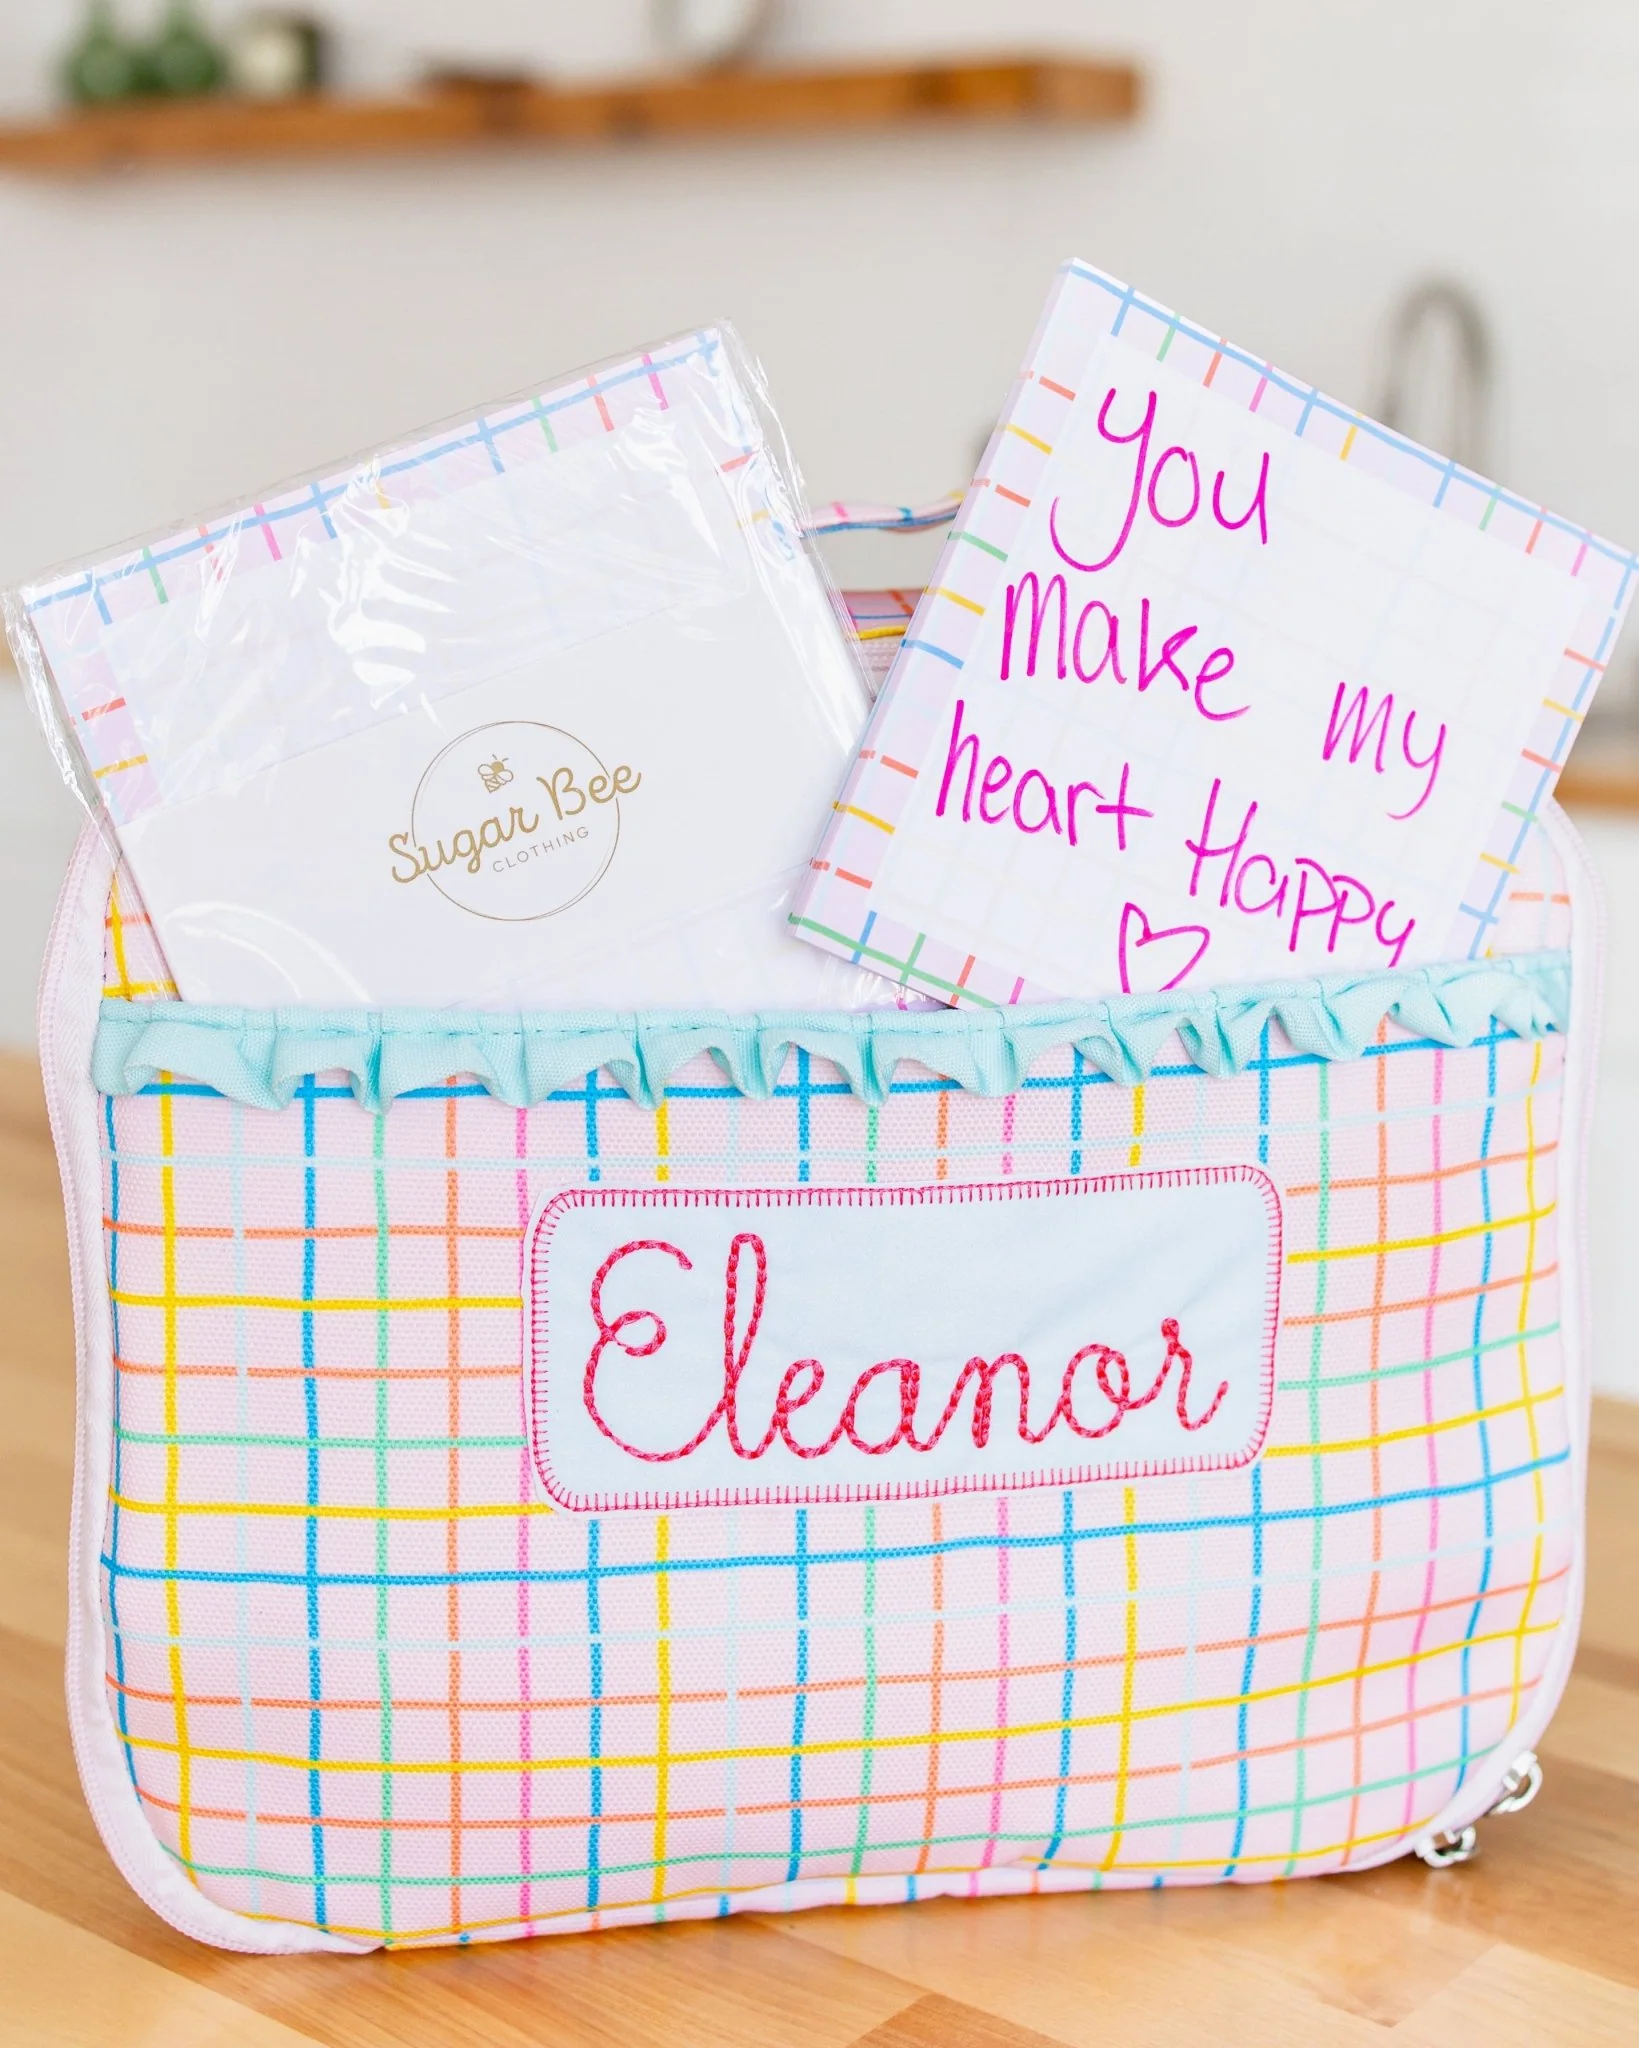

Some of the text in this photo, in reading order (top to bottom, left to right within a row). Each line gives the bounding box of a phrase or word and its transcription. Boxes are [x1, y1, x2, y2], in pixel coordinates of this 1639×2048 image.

[388, 765, 642, 884] Sugar Bee
[492, 825, 589, 873] CLOTHING
[935, 699, 1416, 968] heart Happy
[583, 1232, 1229, 1463] Eleanor
